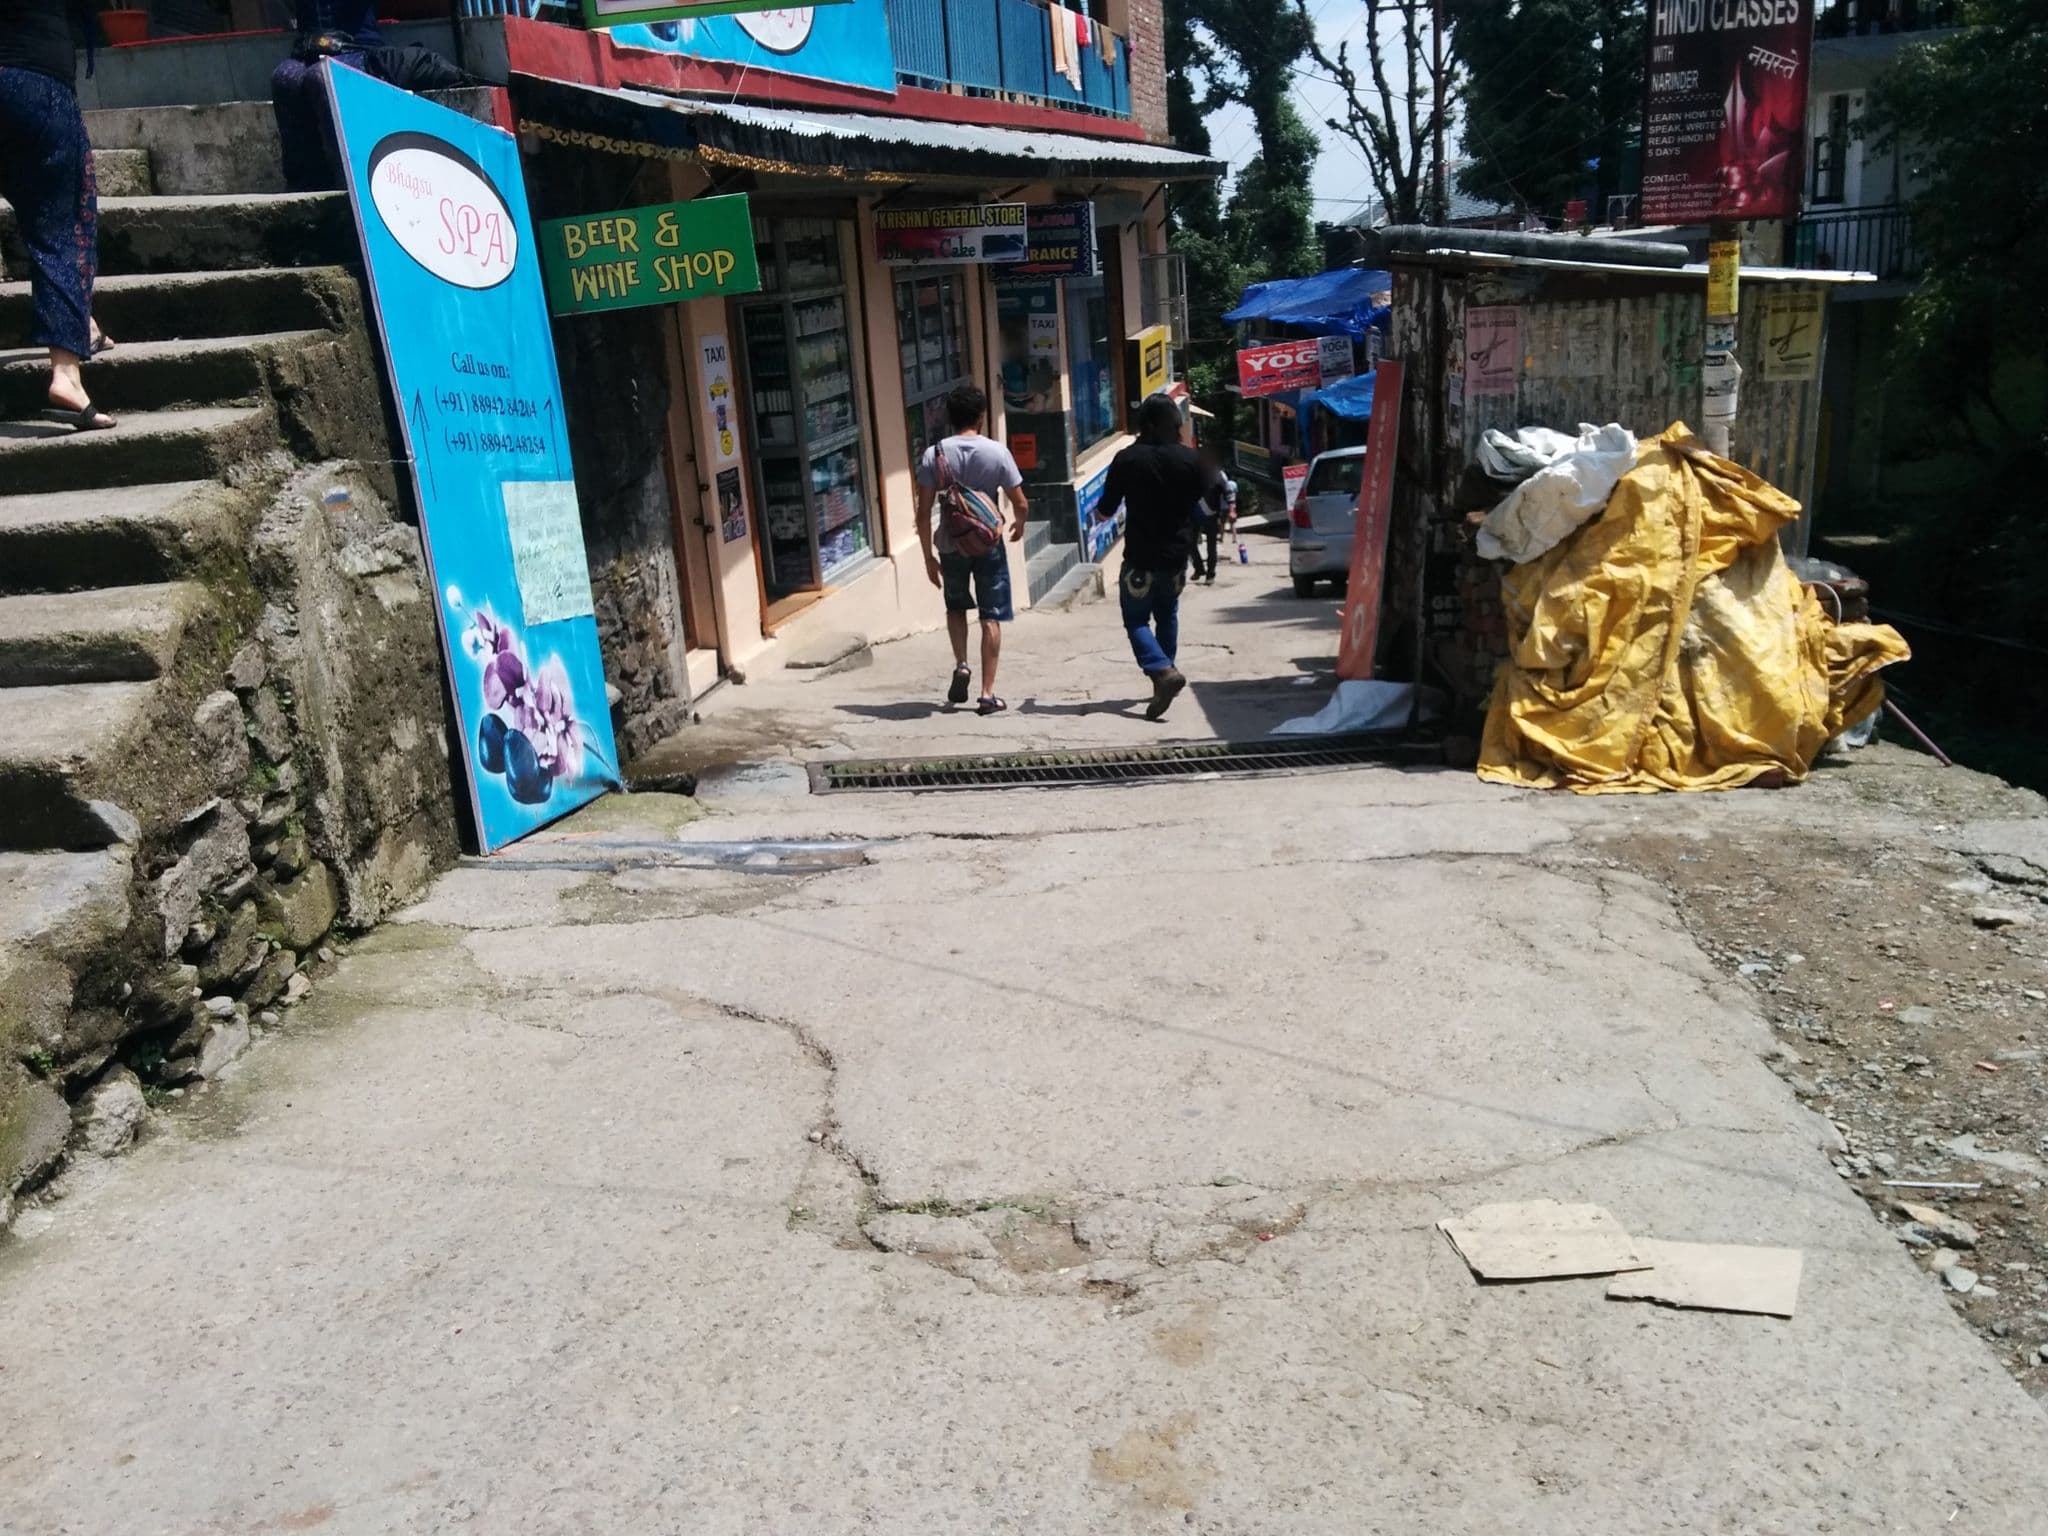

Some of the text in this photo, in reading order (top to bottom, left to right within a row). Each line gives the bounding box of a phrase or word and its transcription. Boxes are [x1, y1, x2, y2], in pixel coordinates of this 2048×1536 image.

[1655, 0, 1800, 37] HINDI CLASSES
[1653, 44, 1675, 63] WITH
[1748, 45, 1801, 81] नमस्ते
[1652, 70, 1699, 92] NARINDER
[1649, 109, 1724, 123] LEARN HOW TO
[1686, 121, 1717, 131] WRITE
[1720, 120, 1727, 129] &
[1648, 133, 1716, 145] READ HINDI IN
[1648, 147, 1680, 157] 5 DAYS
[385, 162, 432, 199] Bhagsu
[879, 207, 1023, 229] KRISHNA GENERAL STORE
[438, 198, 509, 267] SPA
[564, 211, 680, 259] BEER &
[940, 235, 976, 257] Cake
[571, 249, 735, 302] WINE SHOP
[1031, 319, 1056, 329] TAXI
[704, 346, 726, 364] TAXI
[1322, 340, 1349, 353] YOGA
[451, 352, 511, 379] Call us on:
[435, 385, 470, 416] (+91)
[445, 427, 479, 456] (+91)
